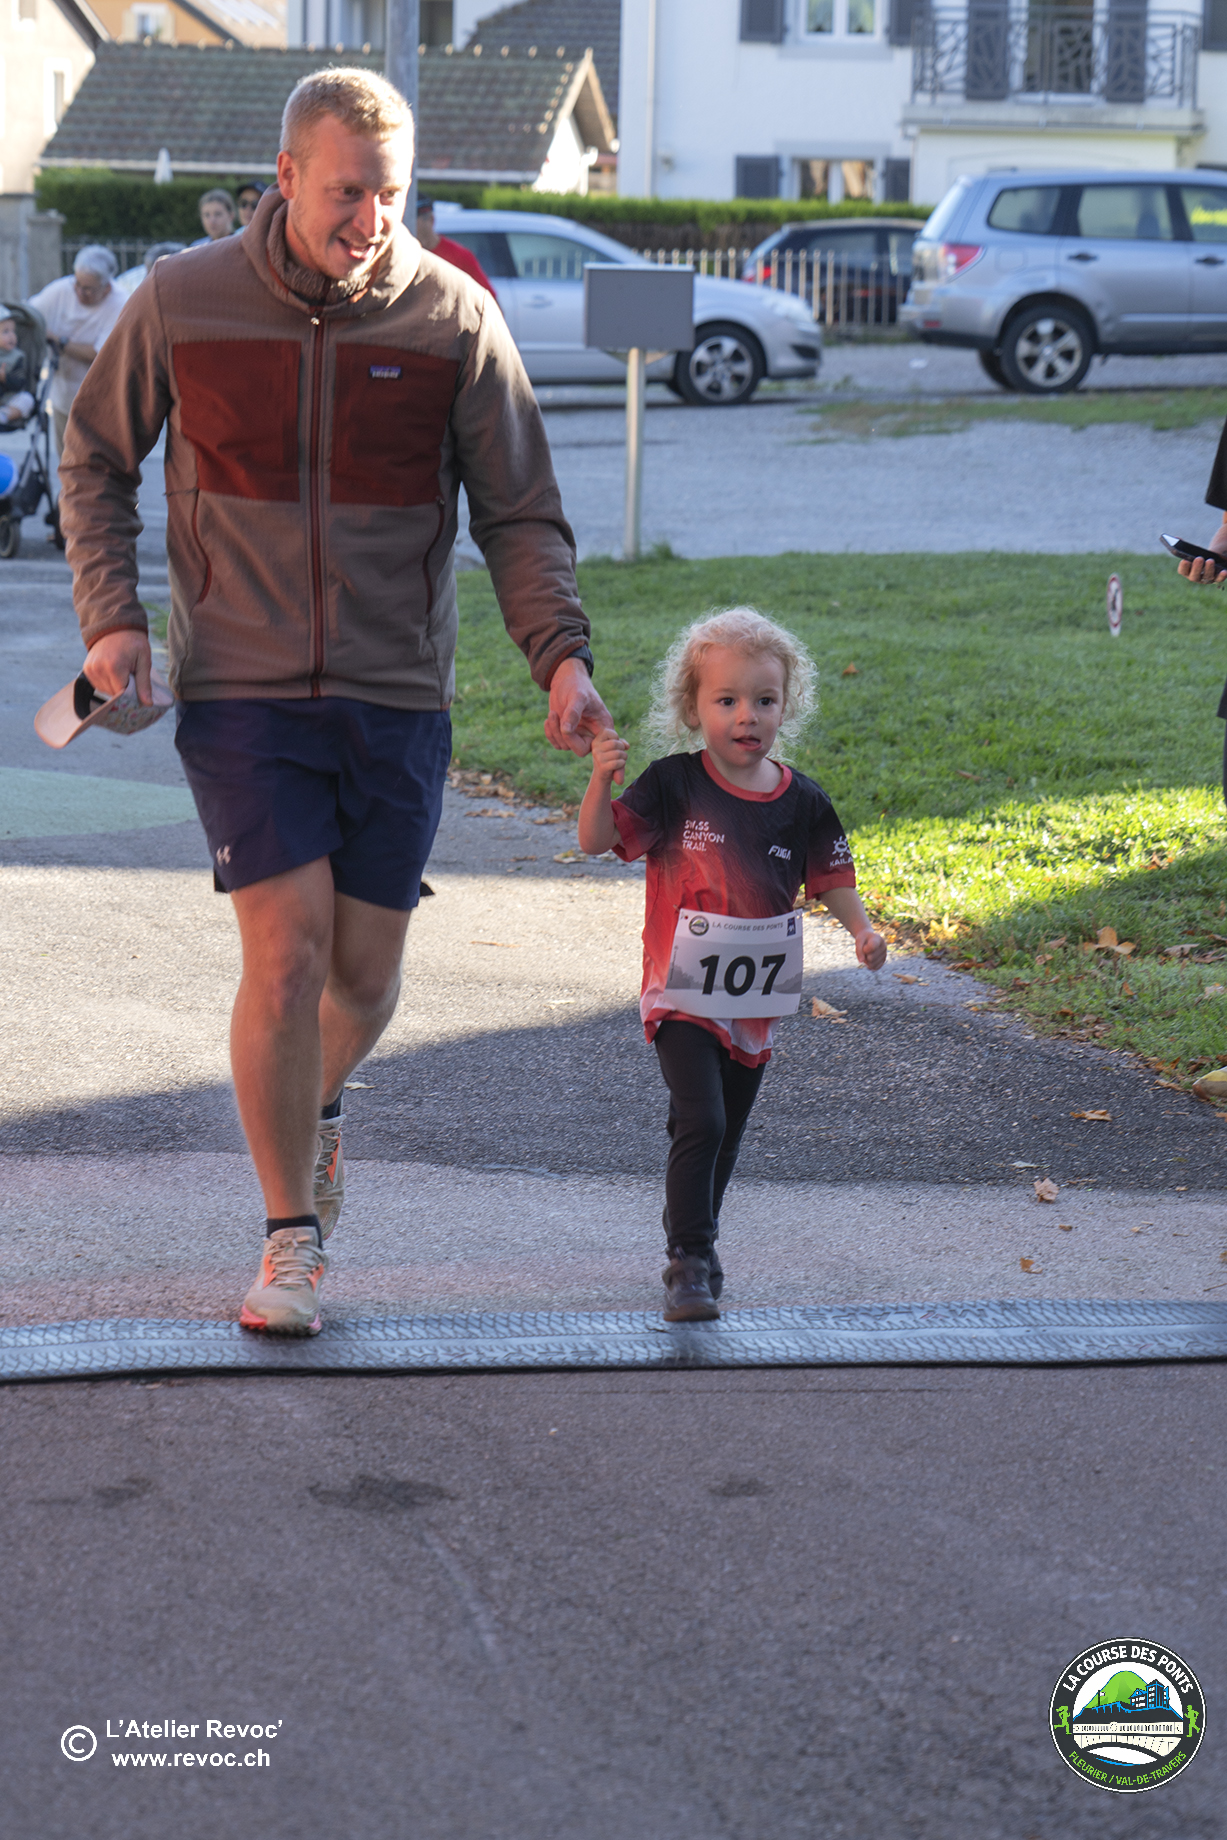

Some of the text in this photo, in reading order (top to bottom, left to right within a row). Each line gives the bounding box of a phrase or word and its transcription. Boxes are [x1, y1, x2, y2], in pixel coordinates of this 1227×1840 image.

[684, 819, 710, 831] SWISS
[682, 830, 725, 844] CANYON
[681, 840, 707, 852] TRAIL
[830, 857, 853, 867] KAILA
[712, 921, 722, 929] LA
[723, 922, 751, 932] COURSE
[752, 924, 765, 932] DES
[766, 921, 784, 931] PONTS
[699, 953, 786, 997] 107
